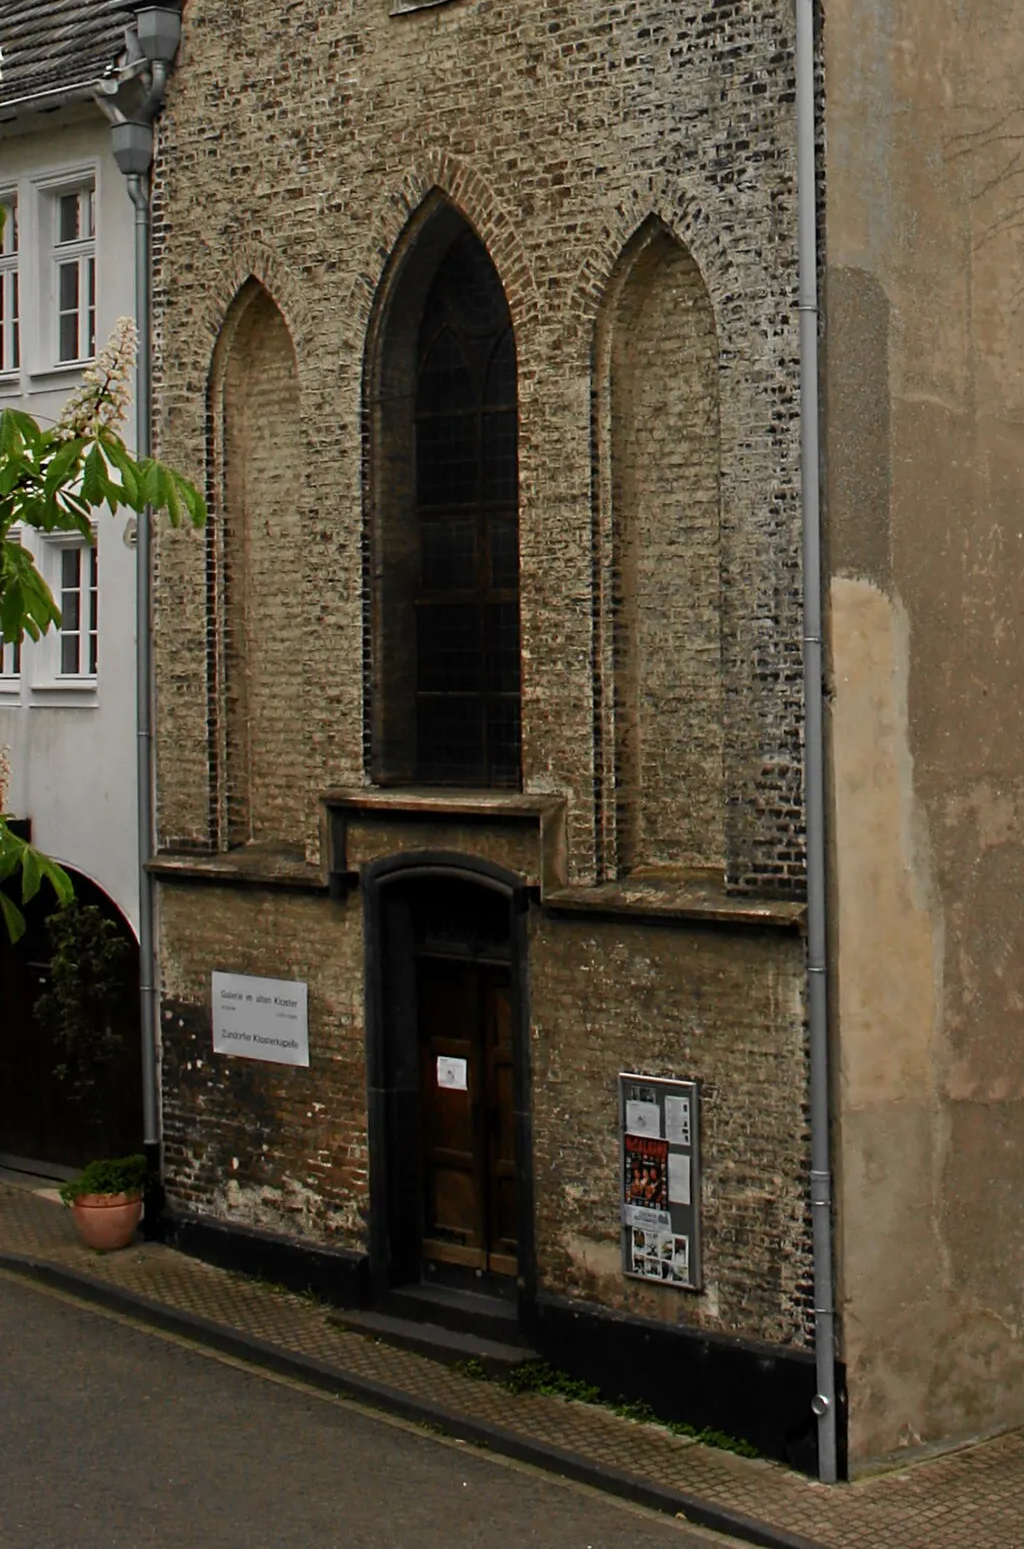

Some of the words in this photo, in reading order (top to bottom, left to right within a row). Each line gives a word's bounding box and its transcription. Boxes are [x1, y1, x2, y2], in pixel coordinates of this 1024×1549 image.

[220, 990, 243, 1001] Galerie
[256, 995, 272, 1004] alten
[274, 996, 298, 1008] Kloster
[253, 1033, 299, 1049] Klosterkapelle
